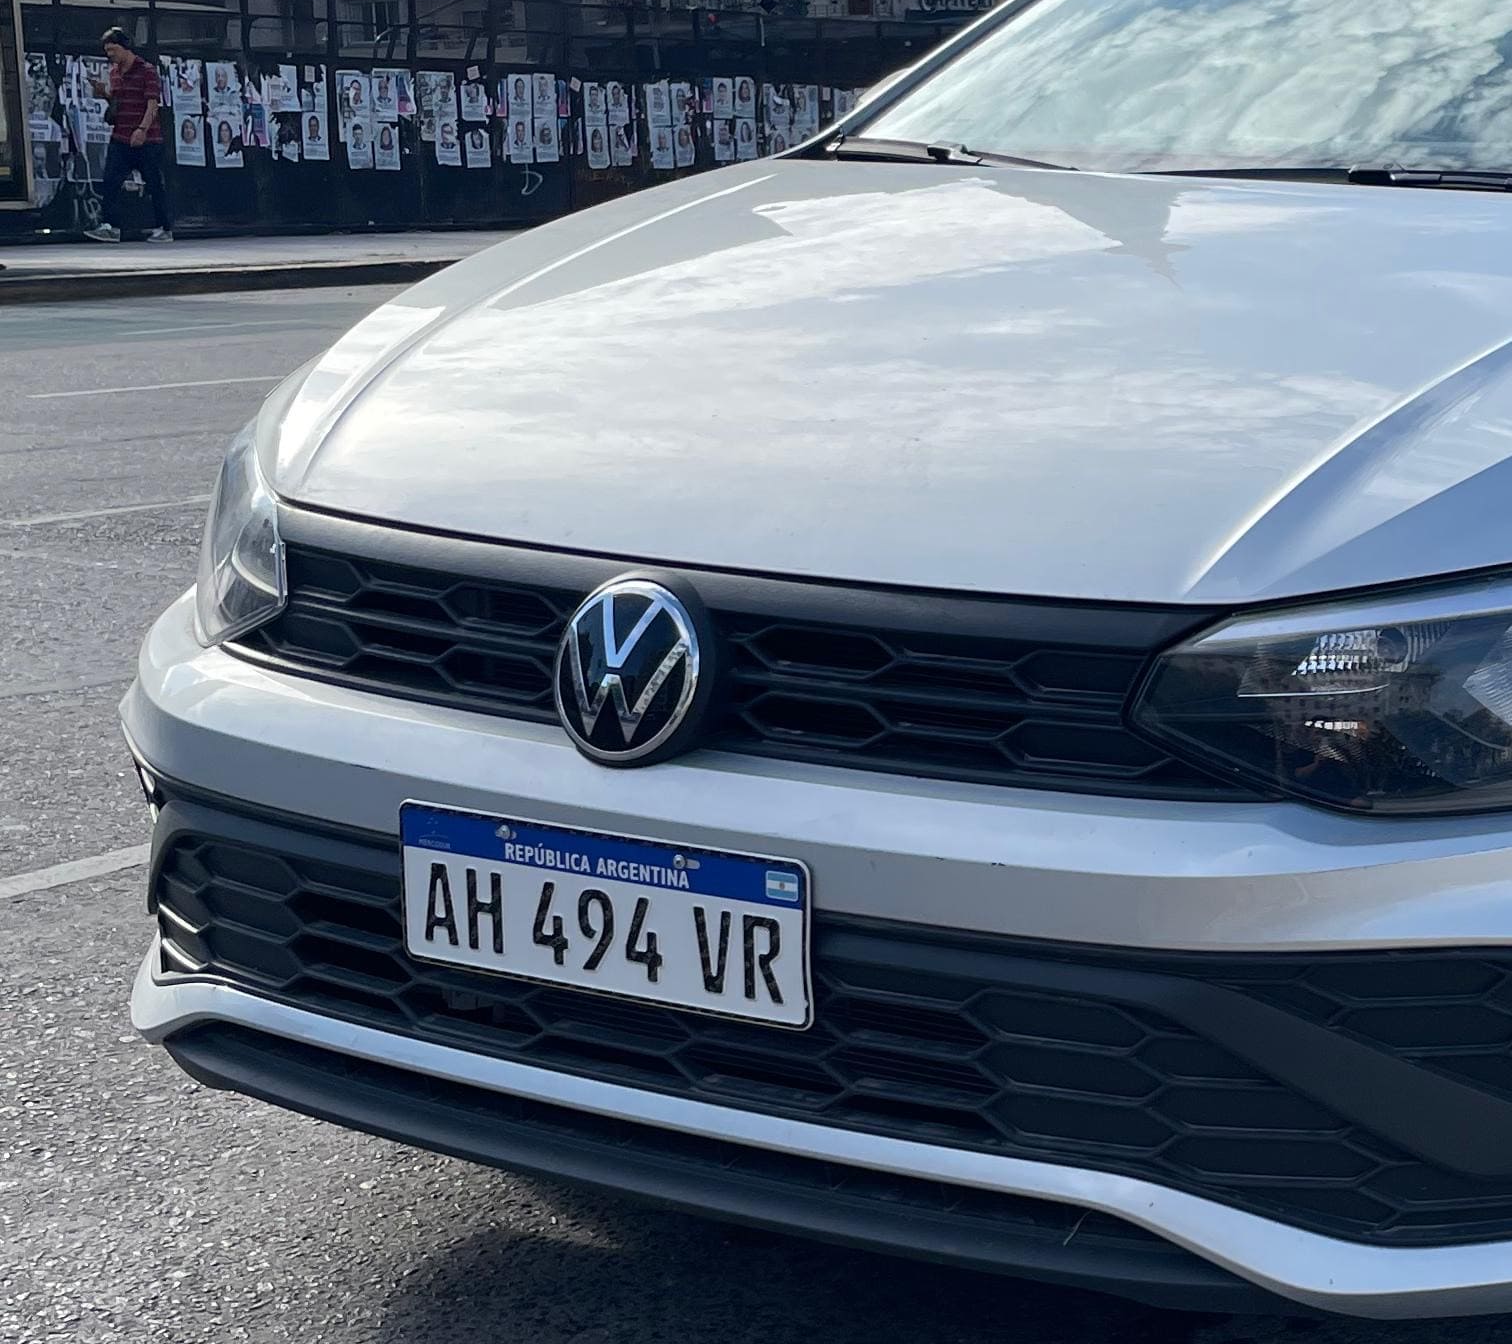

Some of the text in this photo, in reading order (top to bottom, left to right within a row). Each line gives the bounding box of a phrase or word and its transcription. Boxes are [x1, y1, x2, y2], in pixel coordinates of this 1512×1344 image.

[504, 843, 690, 889] REPÚBLICA ARGENTINA
[424, 862, 785, 1004] AH 494 VR
